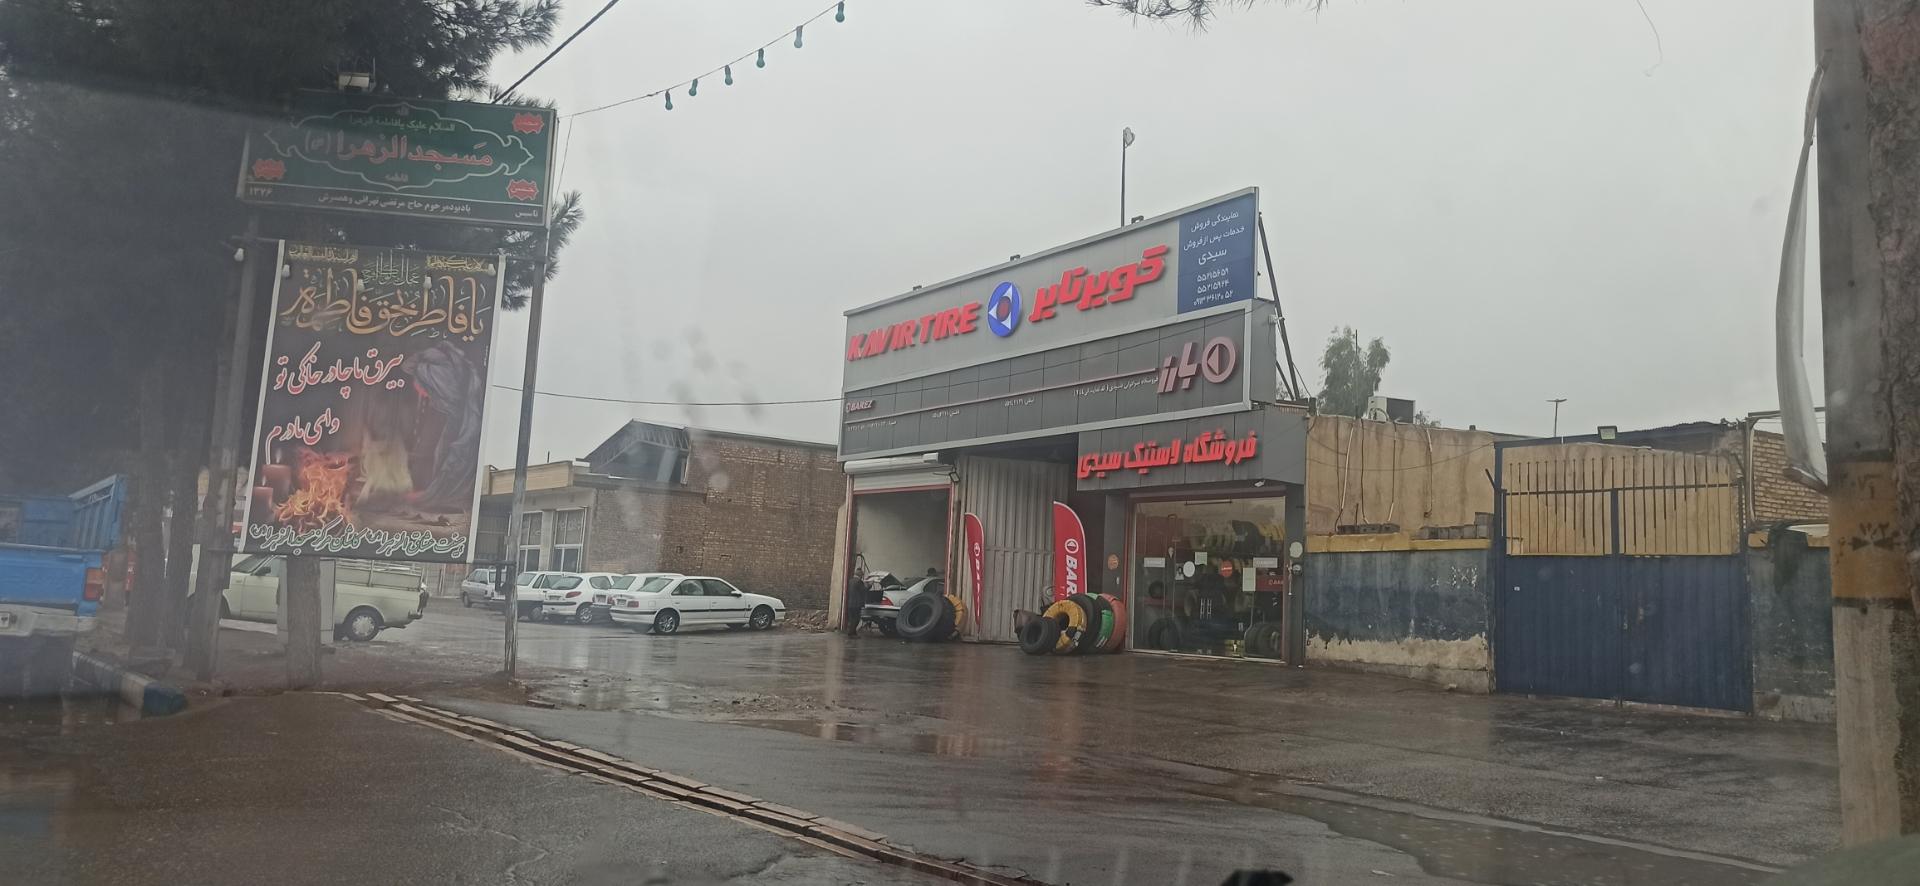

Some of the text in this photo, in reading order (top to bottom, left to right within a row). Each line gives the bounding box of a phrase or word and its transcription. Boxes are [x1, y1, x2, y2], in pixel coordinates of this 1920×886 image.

[406, 120, 427, 131] علیک
[428, 122, 456, 134] السلام
[407, 200, 423, 211] حاج
[1190, 211, 1239, 233] نمایندگی فروش
[1209, 233, 1223, 244] پس
[1223, 225, 1245, 238] خدمات
[1198, 248, 1228, 266] سیدی
[1027, 245, 1170, 323] کویر تایر
[847, 301, 982, 362] KAVIR TIRE
[273, 355, 290, 391] تو
[287, 341, 323, 395] خاکی
[321, 358, 354, 400] چادر
[362, 348, 405, 390] بیرق
[265, 408, 341, 464] وای مادرم
[1077, 427, 1258, 479] فروشگاه لاستیک سیدی
